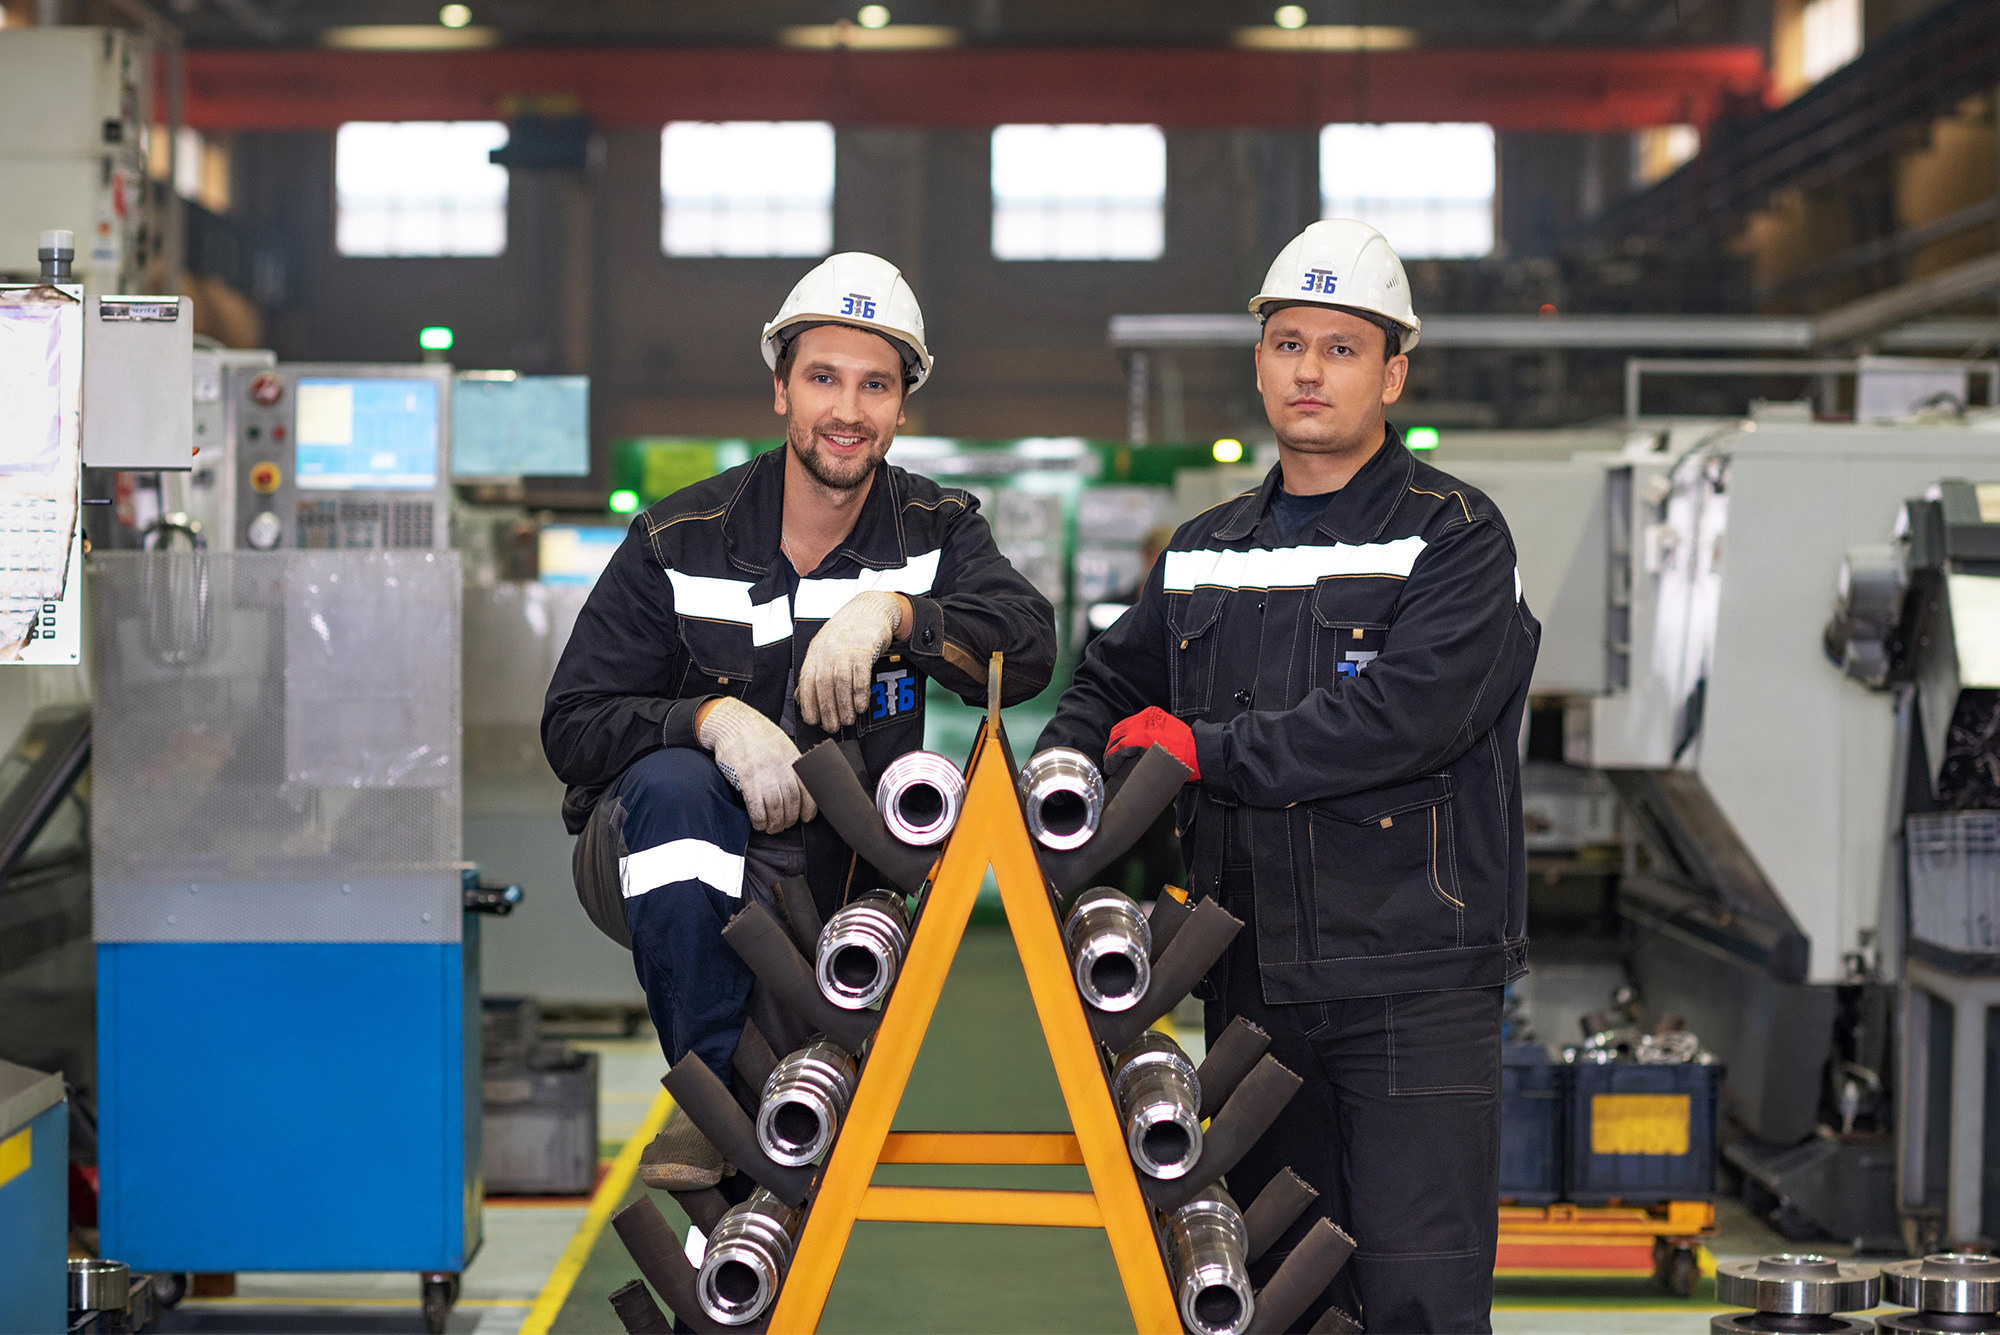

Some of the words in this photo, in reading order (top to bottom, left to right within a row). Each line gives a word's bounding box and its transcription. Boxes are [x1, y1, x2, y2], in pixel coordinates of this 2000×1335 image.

[1301, 268, 1337, 294] ЗТБ
[840, 293, 876, 319] ЗТБ
[871, 669, 915, 720] ЗТБ
